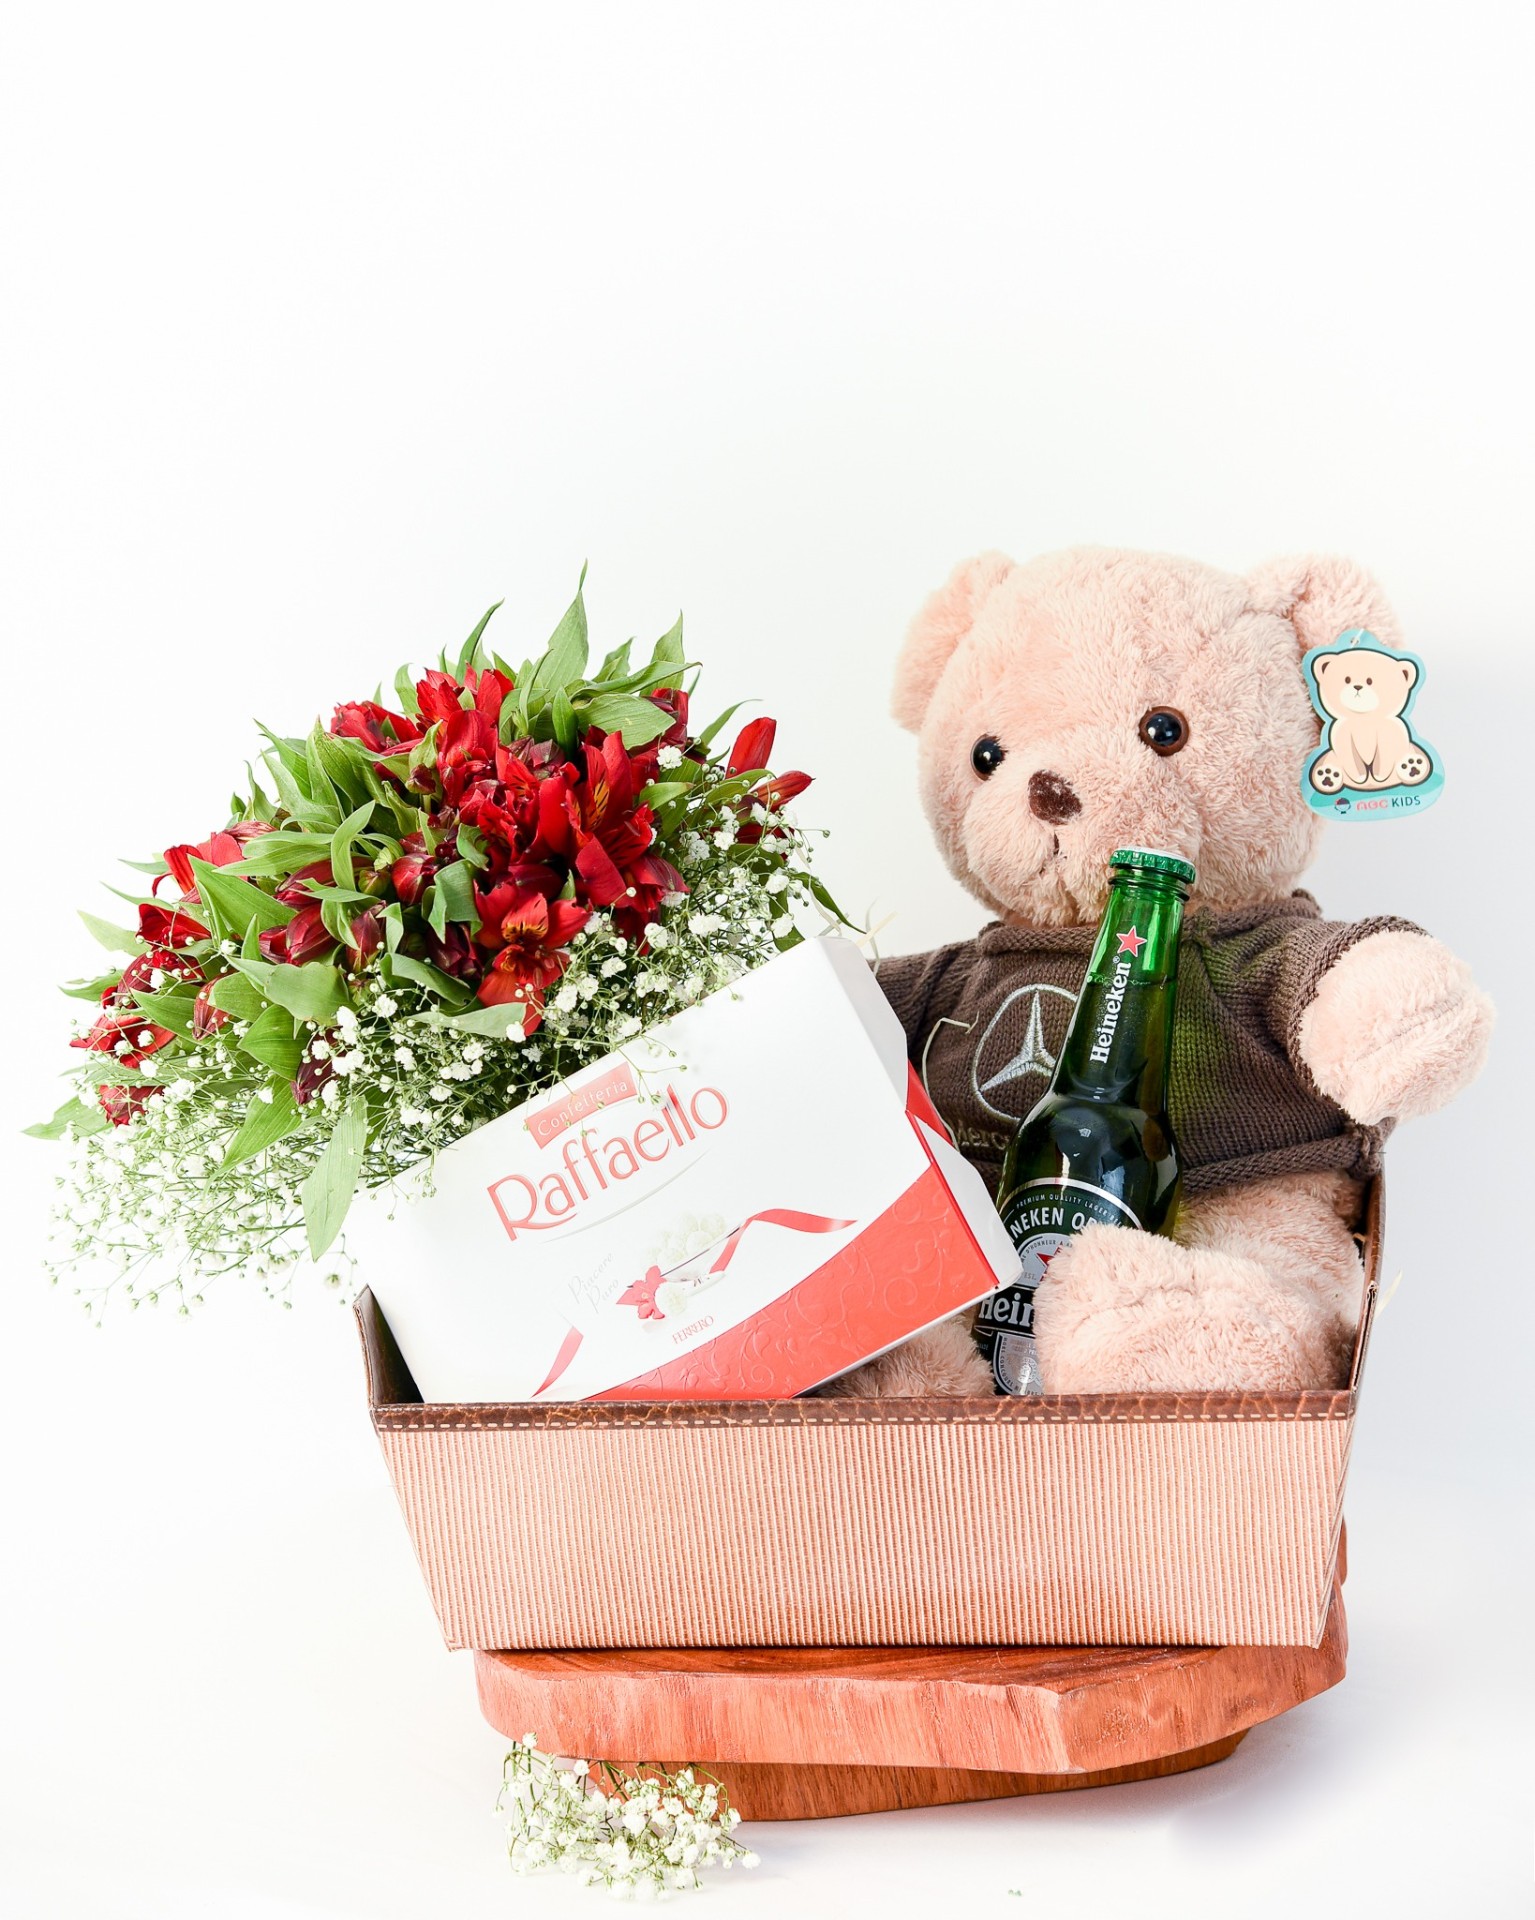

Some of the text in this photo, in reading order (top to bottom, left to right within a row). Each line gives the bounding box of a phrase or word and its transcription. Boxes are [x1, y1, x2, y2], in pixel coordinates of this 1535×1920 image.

[1391, 795, 1421, 807] KIDS
[1090, 962, 1132, 1064] Heineken
[487, 1083, 727, 1241] Raffaello
[1016, 1193, 1046, 1209] PREMIUM
[1049, 1193, 1081, 1204] QUALITY
[1084, 1200, 1108, 1217] LAGER
[1009, 1207, 1064, 1242] NEKEN
[672, 1315, 714, 1344] FERRERO
